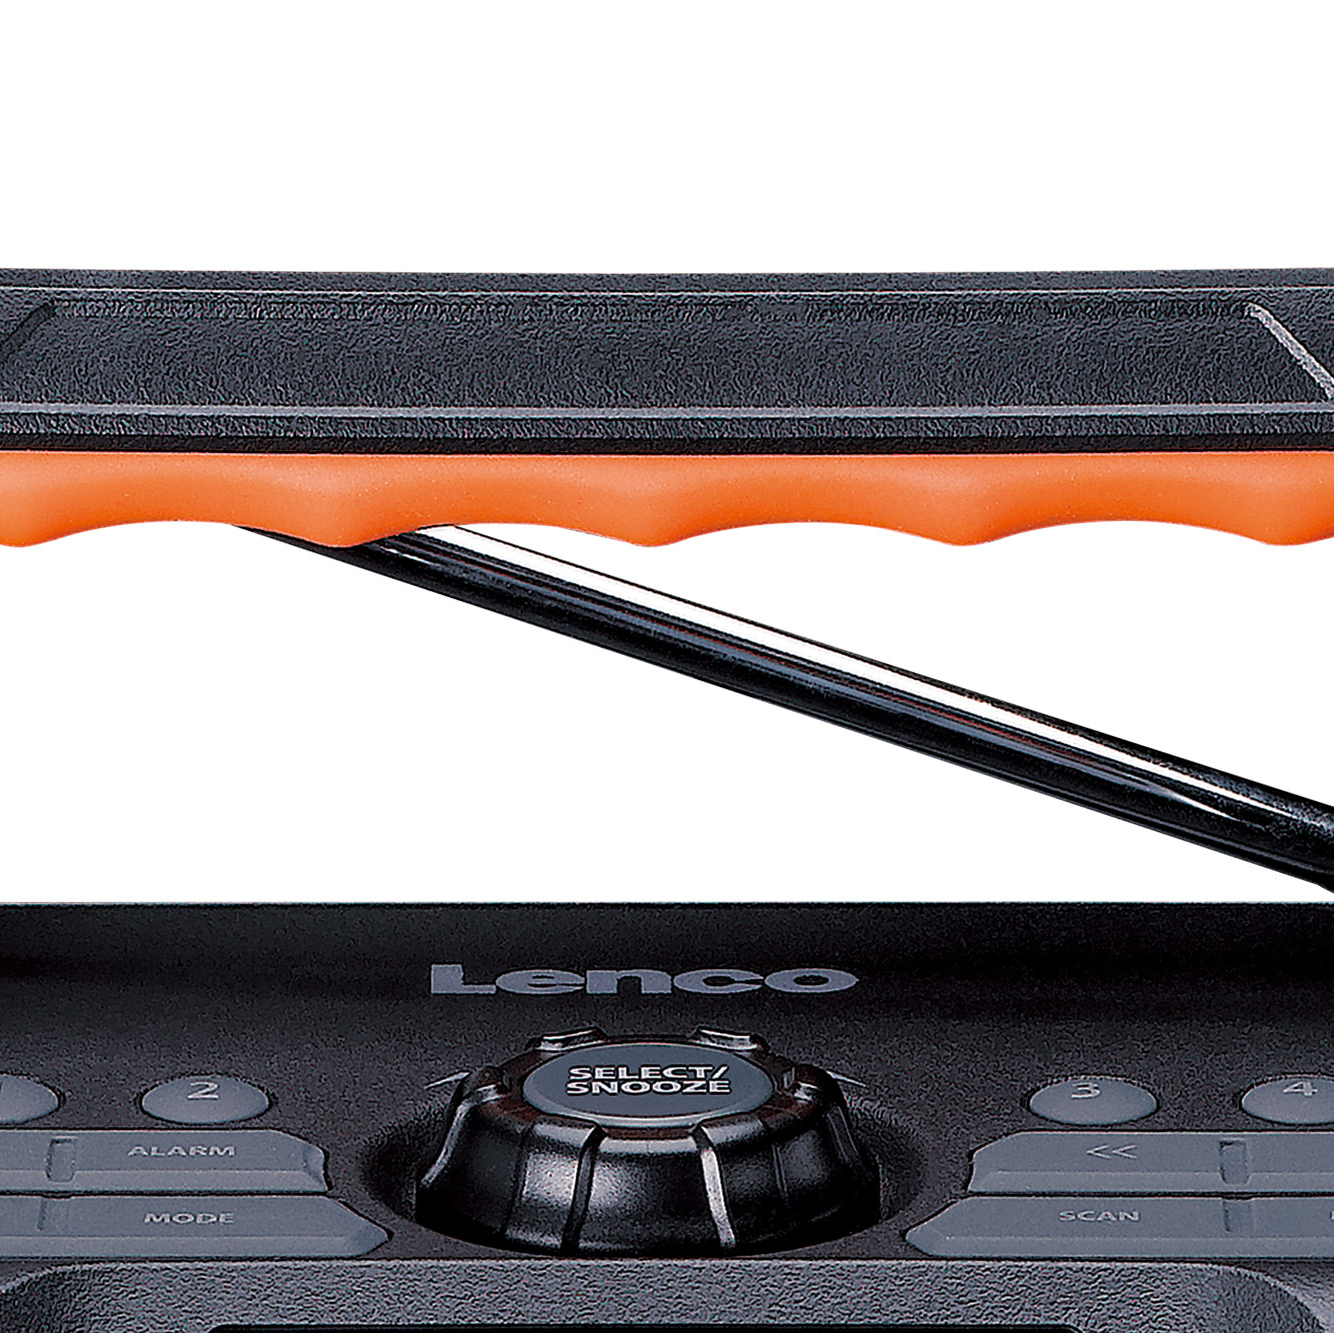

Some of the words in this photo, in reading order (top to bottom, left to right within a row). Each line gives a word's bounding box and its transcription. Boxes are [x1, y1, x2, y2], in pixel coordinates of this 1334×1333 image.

[431, 964, 859, 994] Lenco
[568, 1065, 728, 1081] SELECT/
[186, 1081, 220, 1099] 2
[566, 1080, 731, 1094] SNOOZE
[1070, 1081, 1101, 1099] 3
[1282, 1081, 1318, 1097] 4
[127, 1145, 235, 1157] ALARM
[144, 1211, 234, 1224] MODE
[1059, 1210, 1140, 1222] SCAN
